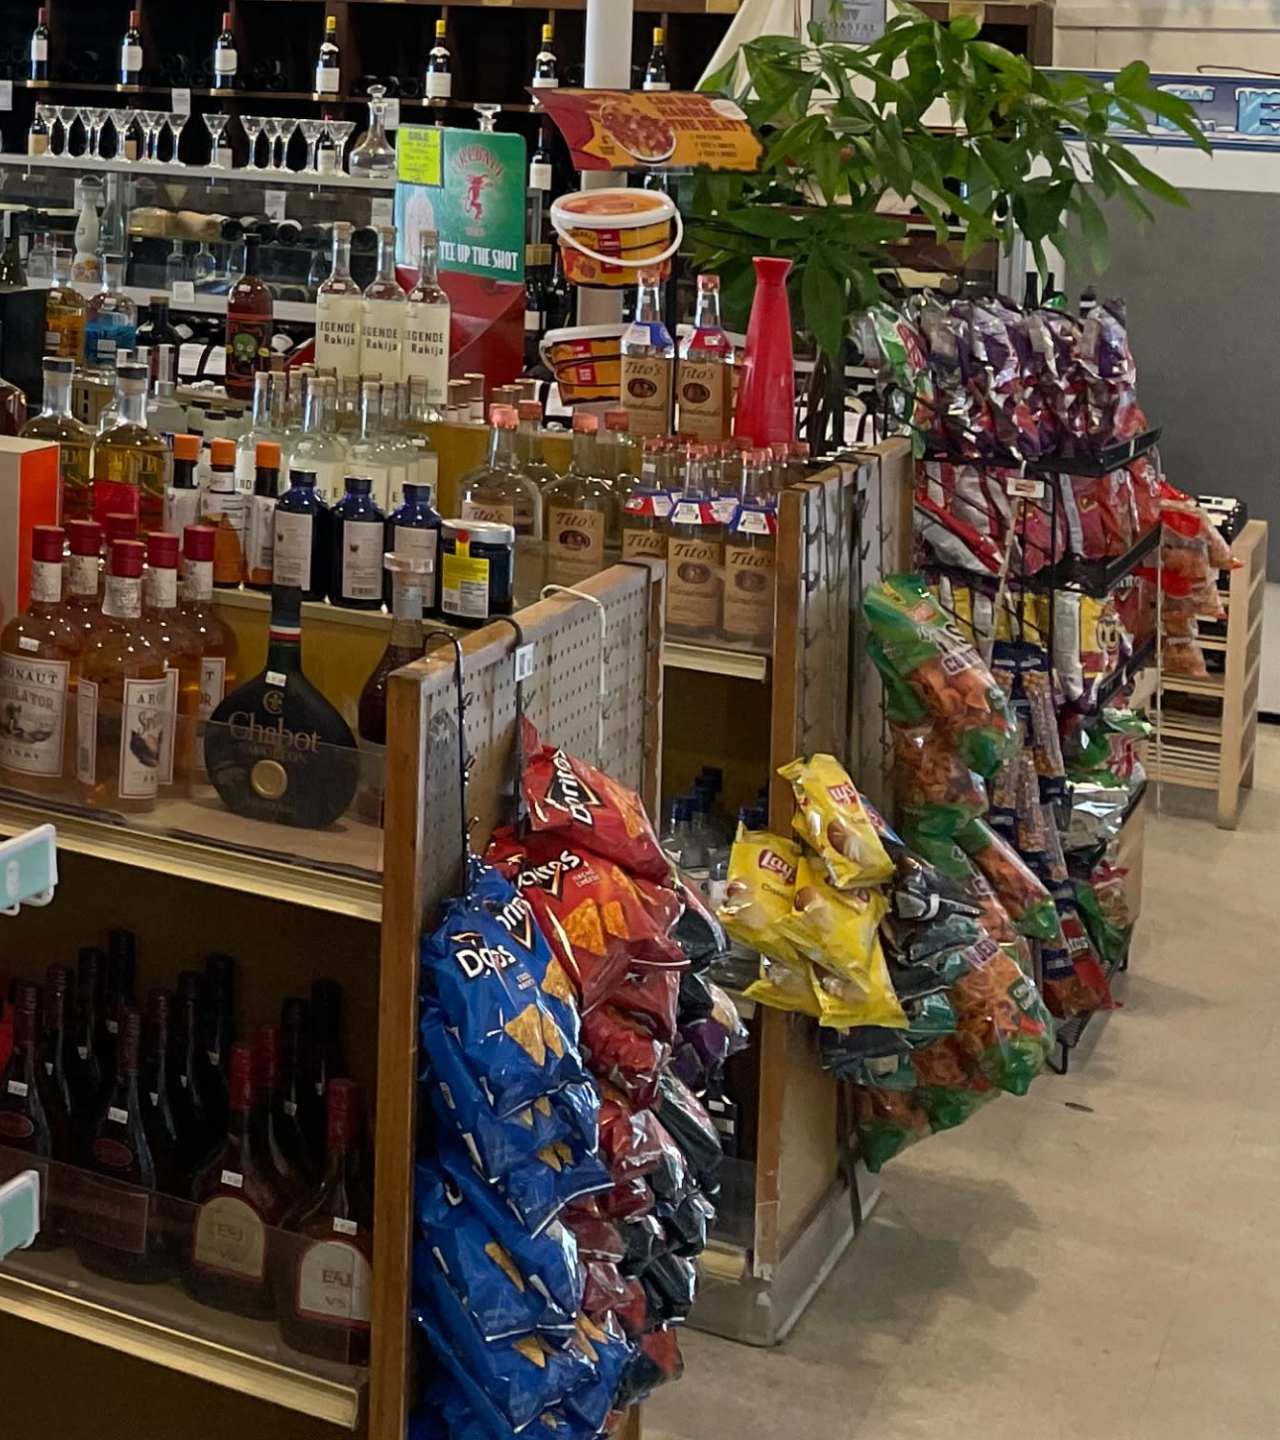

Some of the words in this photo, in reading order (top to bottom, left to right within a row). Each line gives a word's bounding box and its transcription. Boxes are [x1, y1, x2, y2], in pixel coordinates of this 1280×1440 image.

[457, 244, 471, 262] UP
[472, 246, 491, 265] THE
[492, 249, 519, 271] SHOT
[362, 326, 399, 339] EGENDE
[407, 329, 444, 343] EGENDE
[624, 360, 663, 377] Tito's
[673, 542, 716, 560] Tito's
[227, 711, 322, 755] Chabot
[519, 849, 582, 890] oritos
